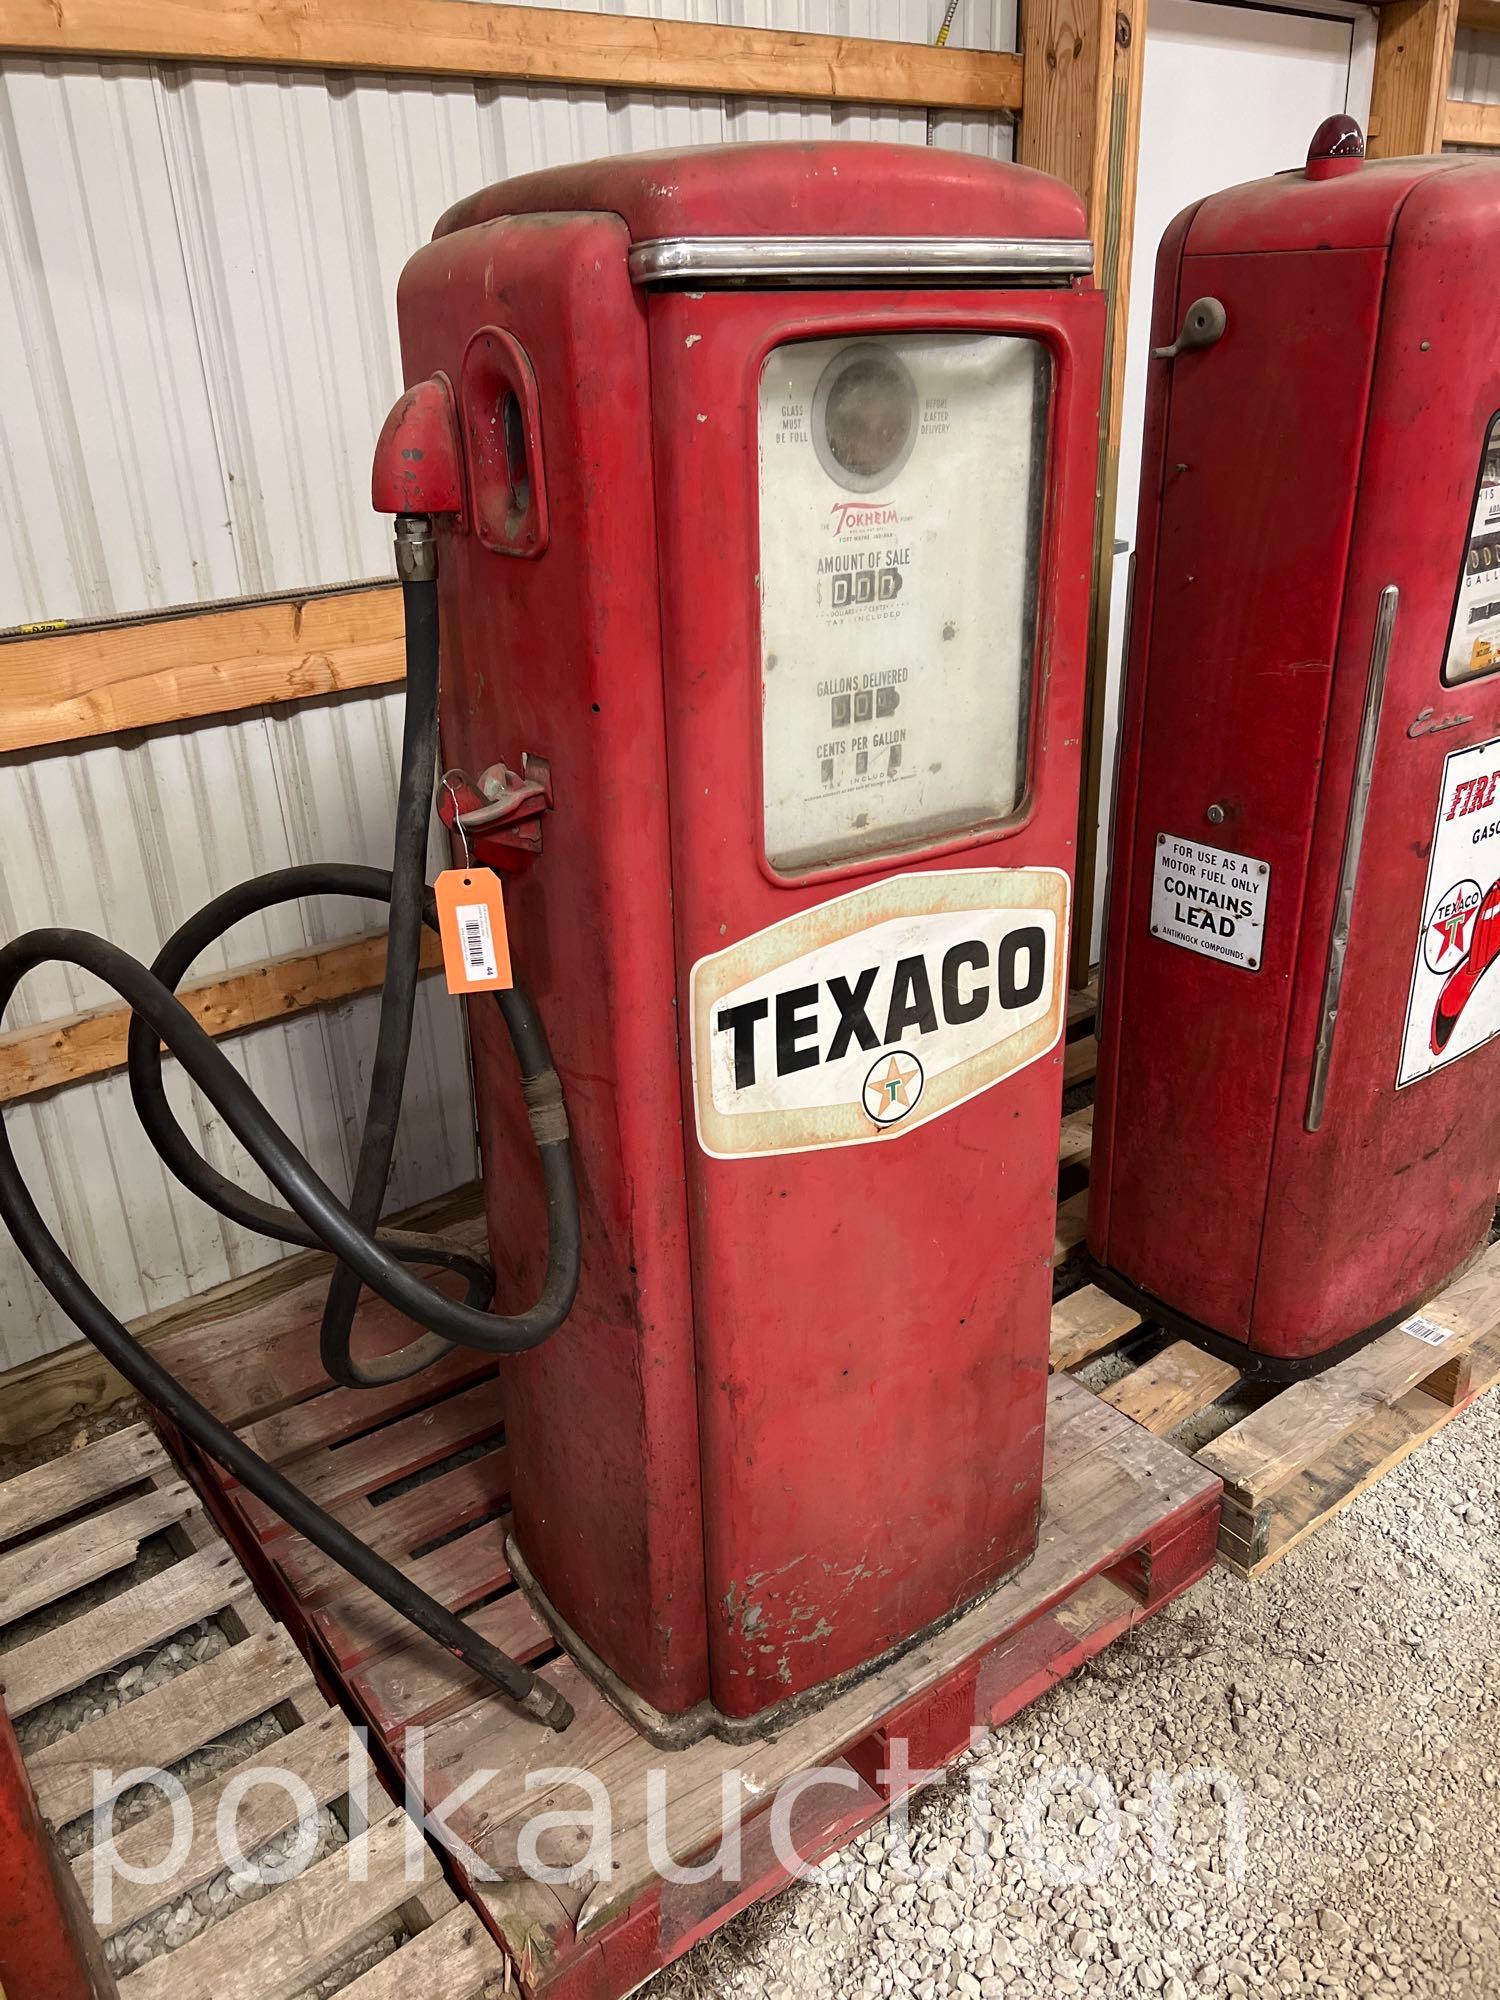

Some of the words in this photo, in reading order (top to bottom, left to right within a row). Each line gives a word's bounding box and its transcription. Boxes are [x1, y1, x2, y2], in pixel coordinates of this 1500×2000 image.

[781, 404, 803, 417] GLASS
[925, 399, 947, 409] BEFORE
[776, 432, 786, 444] BE
[790, 431, 808, 443] FULL
[782, 418, 801, 430] MUST
[920, 423, 951, 435] DELIVERY
[830, 500, 899, 537] TOKHEIM
[817, 553, 865, 575] AMOUNT
[868, 551, 881, 569] OF
[885, 548, 910, 567] SALE
[854, 611, 901, 622] INCLUDED
[816, 675, 859, 697] GALLONS
[862, 667, 908, 689] DELIVERED
[816, 740, 846, 759] CENTS
[851, 736, 868, 752] PER
[873, 728, 906, 747] GALLON
[1173, 843, 1193, 859] FOR
[1197, 851, 1218, 866] USE
[1222, 858, 1236, 872] AS
[1241, 863, 1249, 875] A
[1161, 856, 1196, 876] MOTOR
[1200, 868, 1226, 886] FUEL
[1231, 877, 1260, 894] ONLY
[1164, 876, 1253, 917] CONTAINS
[1438, 890, 1480, 920] TEXACO
[1174, 902, 1236, 938] LEAD
[1445, 915, 1464, 946] T
[1162, 926, 1199, 946] ANTIKNOCK
[1200, 940, 1244, 960] COMPOUNDS
[717, 926, 1046, 1090] TEXACO
[885, 1079, 902, 1102] T
